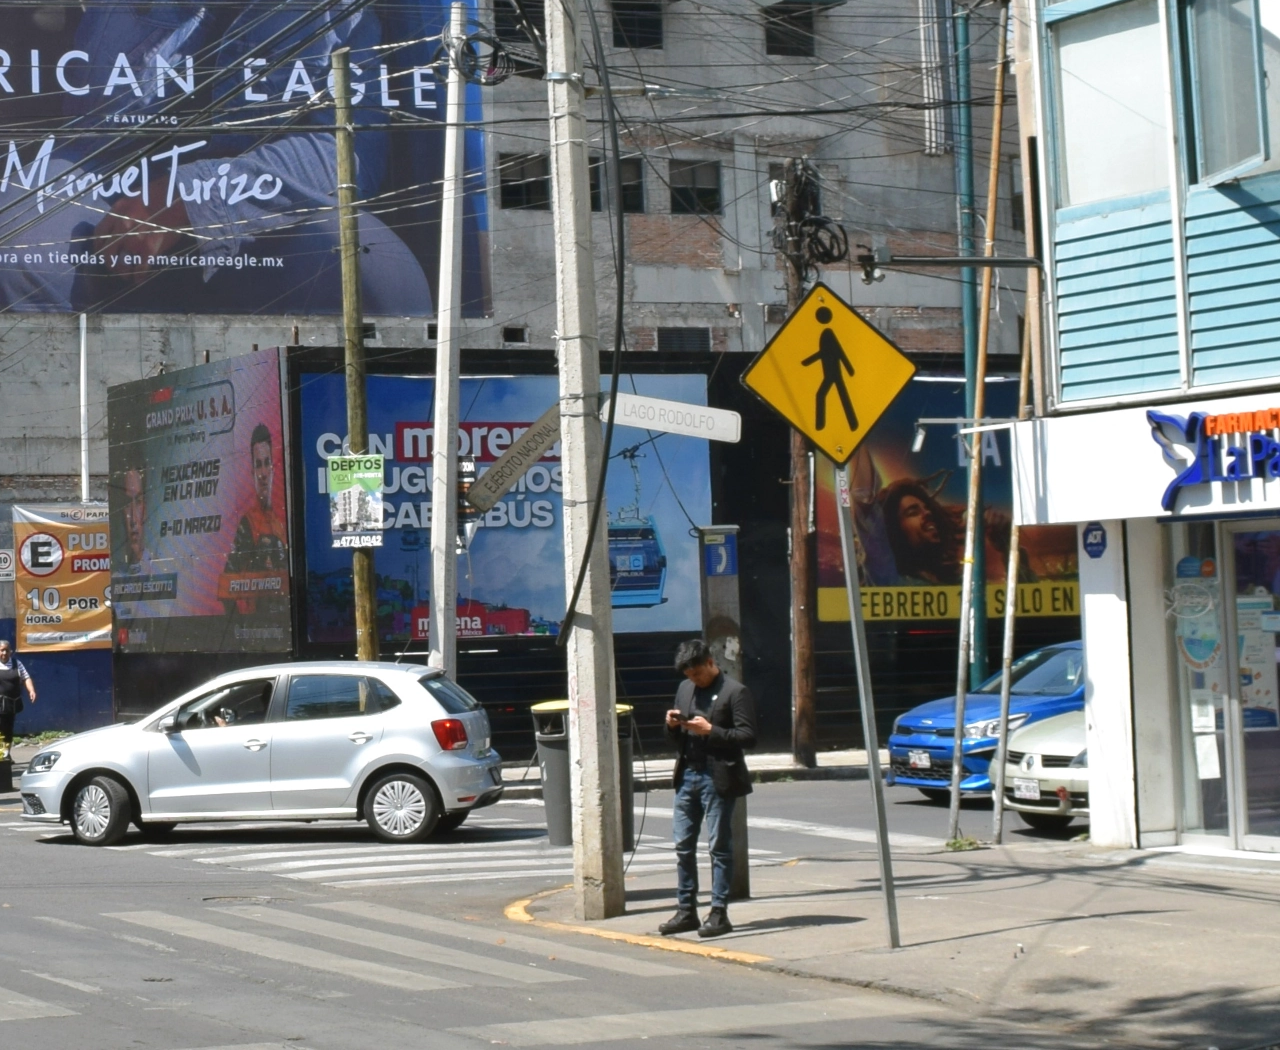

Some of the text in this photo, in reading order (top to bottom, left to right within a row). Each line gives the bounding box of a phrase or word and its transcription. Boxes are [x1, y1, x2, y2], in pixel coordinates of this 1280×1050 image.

[243, 58, 437, 108] EAGLE
[1, 135, 283, 214] Manuel Turizo
[24, 253, 42, 263] en
[49, 251, 105, 264] tiendas
[110, 254, 119, 267] y
[123, 254, 142, 264] en
[147, 254, 284, 269] americaneagle.mx
[146, 410, 174, 429] GRAND
[175, 405, 195, 423] PRIX
[623, 403, 715, 431] LAGO RODOLFO
[1205, 408, 1280, 436] FARMAC
[331, 459, 382, 471] DEPTOS
[484, 423, 558, 493] EJÉRCITO NACIONAL
[1207, 438, 1241, 482] La
[161, 459, 221, 483] MEXICANOS
[163, 484, 178, 502] EN
[180, 482, 193, 500] LA
[184, 515, 222, 534] MARZO
[1086, 530, 1103, 544] ADT
[0, 556, 9, 564] 10
[30, 541, 54, 569] E
[229, 579, 249, 592] PATO
[26, 588, 99, 611] 10 POR
[860, 587, 1074, 617] FEBRERO SLO EN
[26, 615, 62, 623] HORAS
[418, 616, 482, 630] mena
